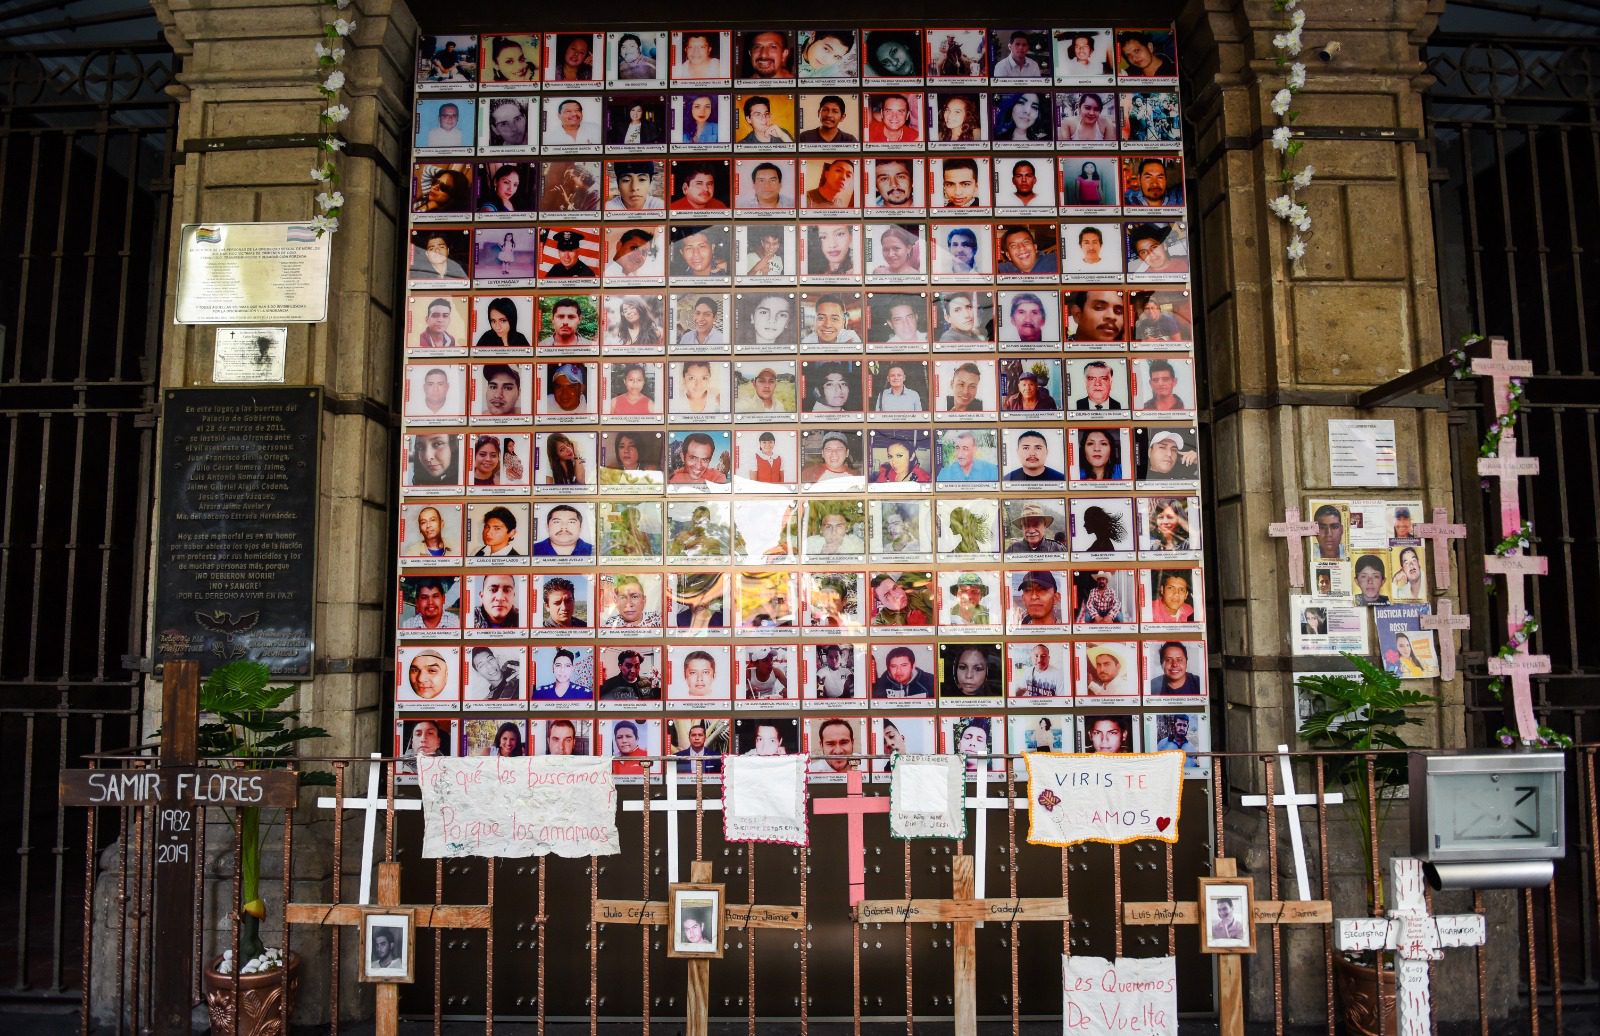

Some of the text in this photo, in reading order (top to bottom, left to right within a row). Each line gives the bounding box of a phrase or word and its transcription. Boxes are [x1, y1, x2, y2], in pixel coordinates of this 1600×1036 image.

[1377, 608, 1418, 618] JUSTICIA PARA
[1390, 623, 1408, 631] ROSSY
[456, 761, 484, 794] qué
[496, 756, 516, 784] los
[1055, 772, 1148, 790] VIRIS TE
[88, 773, 263, 802] SAMIR FLORES
[160, 810, 190, 832] 1982
[440, 806, 610, 848] Porque los amamos
[158, 845, 188, 863] 2019
[603, 906, 623, 919] Julio
[863, 905, 894, 918] Gabriel
[991, 903, 1024, 914] Cadena
[1131, 908, 1184, 920] Luis Antonio
[1254, 907, 1318, 920] Romero Jaime
[761, 910, 790, 922] Jaime
[1344, 930, 1385, 940] SECUESTRO
[1064, 968, 1176, 994] Les Queremos
[1067, 1001, 1167, 1032] De Vuelta
